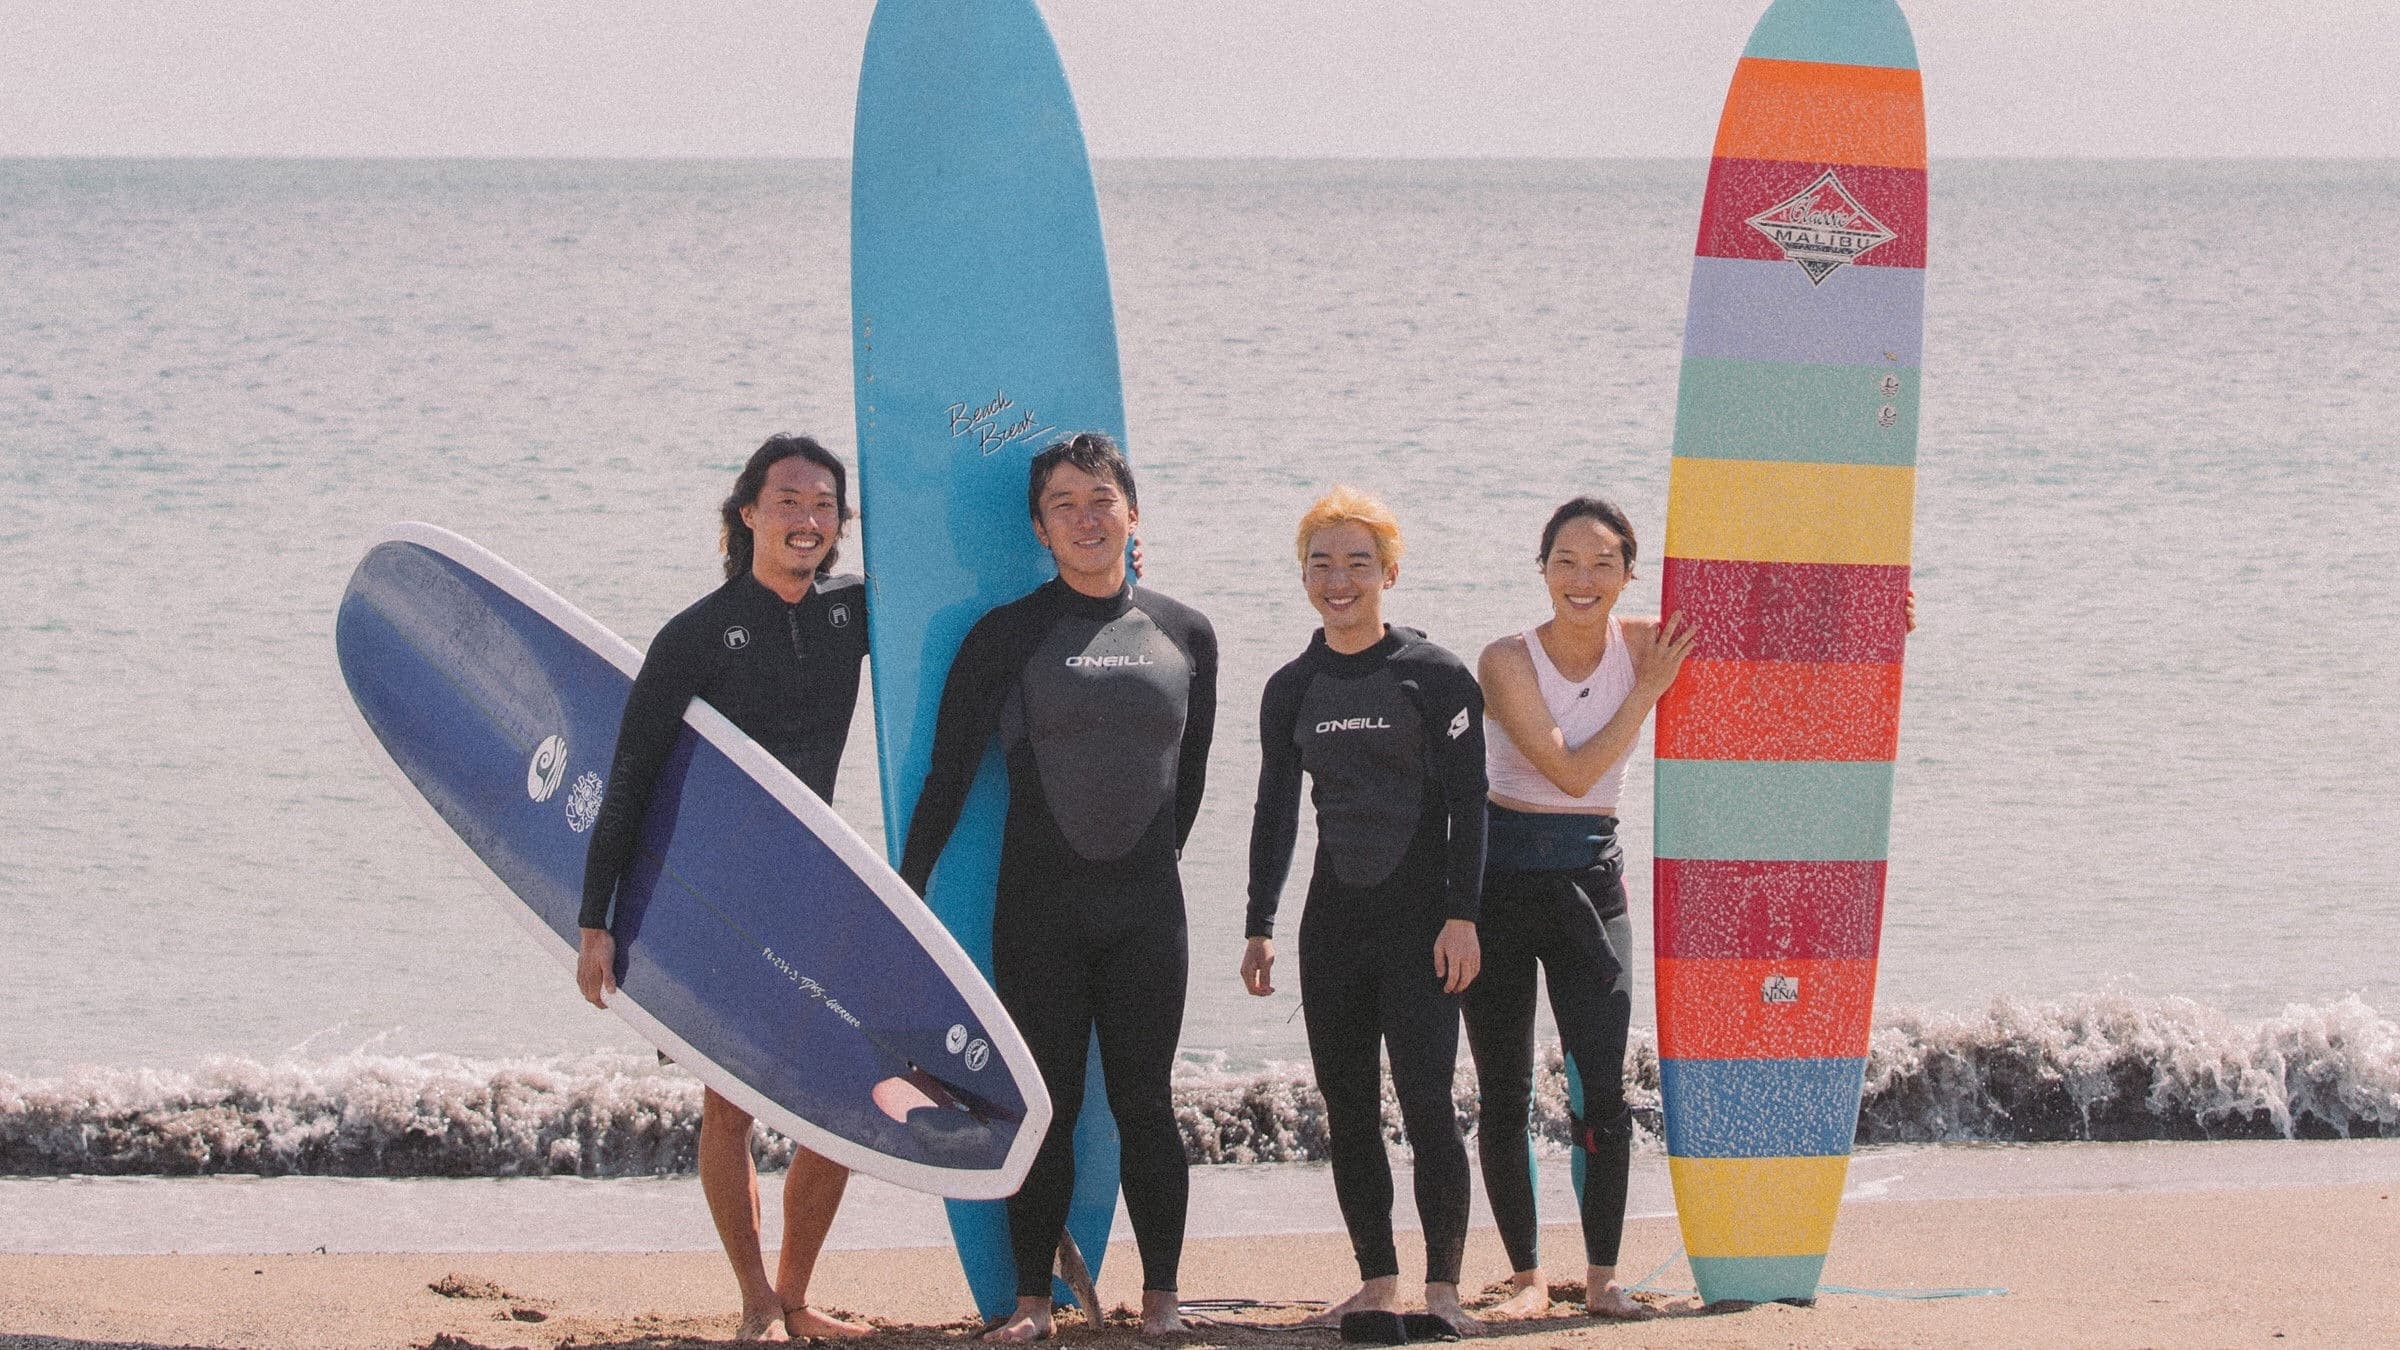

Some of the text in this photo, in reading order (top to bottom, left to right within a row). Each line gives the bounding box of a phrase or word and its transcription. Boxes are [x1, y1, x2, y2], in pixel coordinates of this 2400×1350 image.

[1788, 195, 1853, 229] Classic
[1774, 228, 1869, 249] MALIBU
[944, 388, 1014, 438] Beach
[972, 409, 1039, 456] Break
[1065, 655, 1154, 667] O'NEILL
[1315, 717, 1391, 733] O'NEILL
